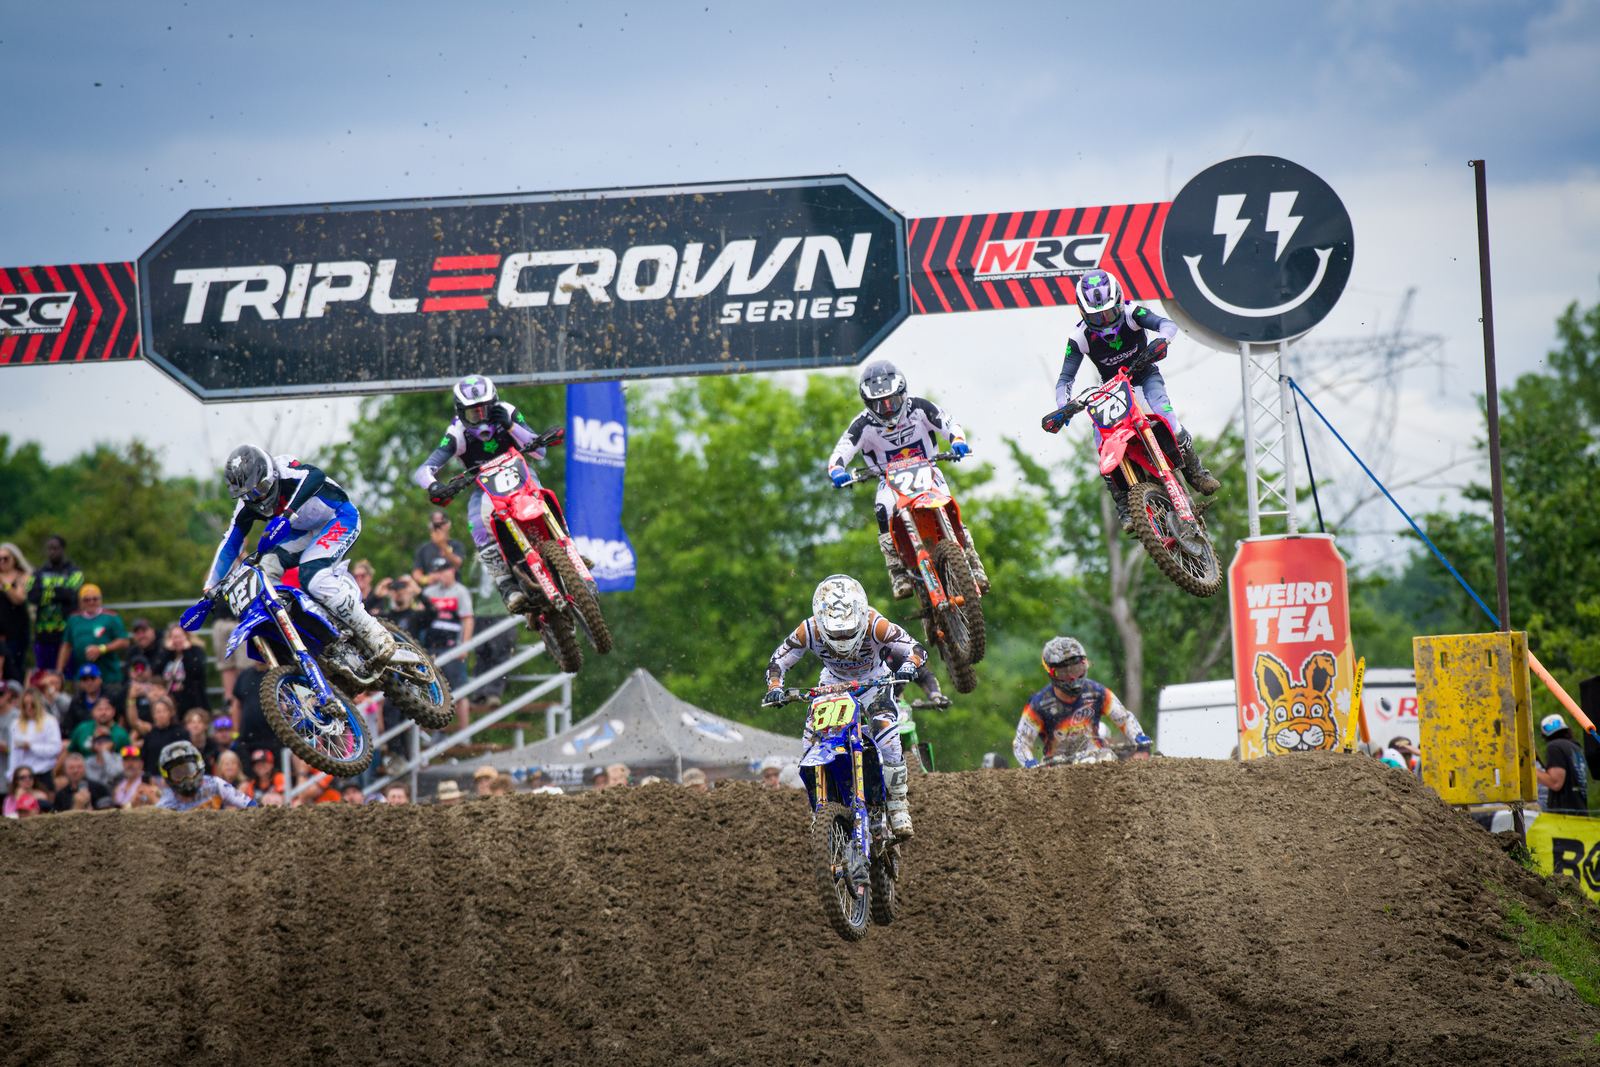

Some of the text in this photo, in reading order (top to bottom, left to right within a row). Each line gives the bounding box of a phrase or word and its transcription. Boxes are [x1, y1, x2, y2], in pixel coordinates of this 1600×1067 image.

[497, 232, 872, 308] CROWN
[978, 237, 1105, 274] MRC
[974, 273, 1029, 282] MOTORSPORT
[1030, 270, 1062, 278] RACING
[0, 295, 72, 328] RC
[720, 295, 858, 324] SERIES
[573, 416, 625, 455] MG
[894, 465, 934, 496] 24
[574, 536, 634, 570] MG
[1246, 581, 1333, 608] WEIRD
[1250, 605, 1335, 645] TEA
[813, 699, 857, 732] 80
